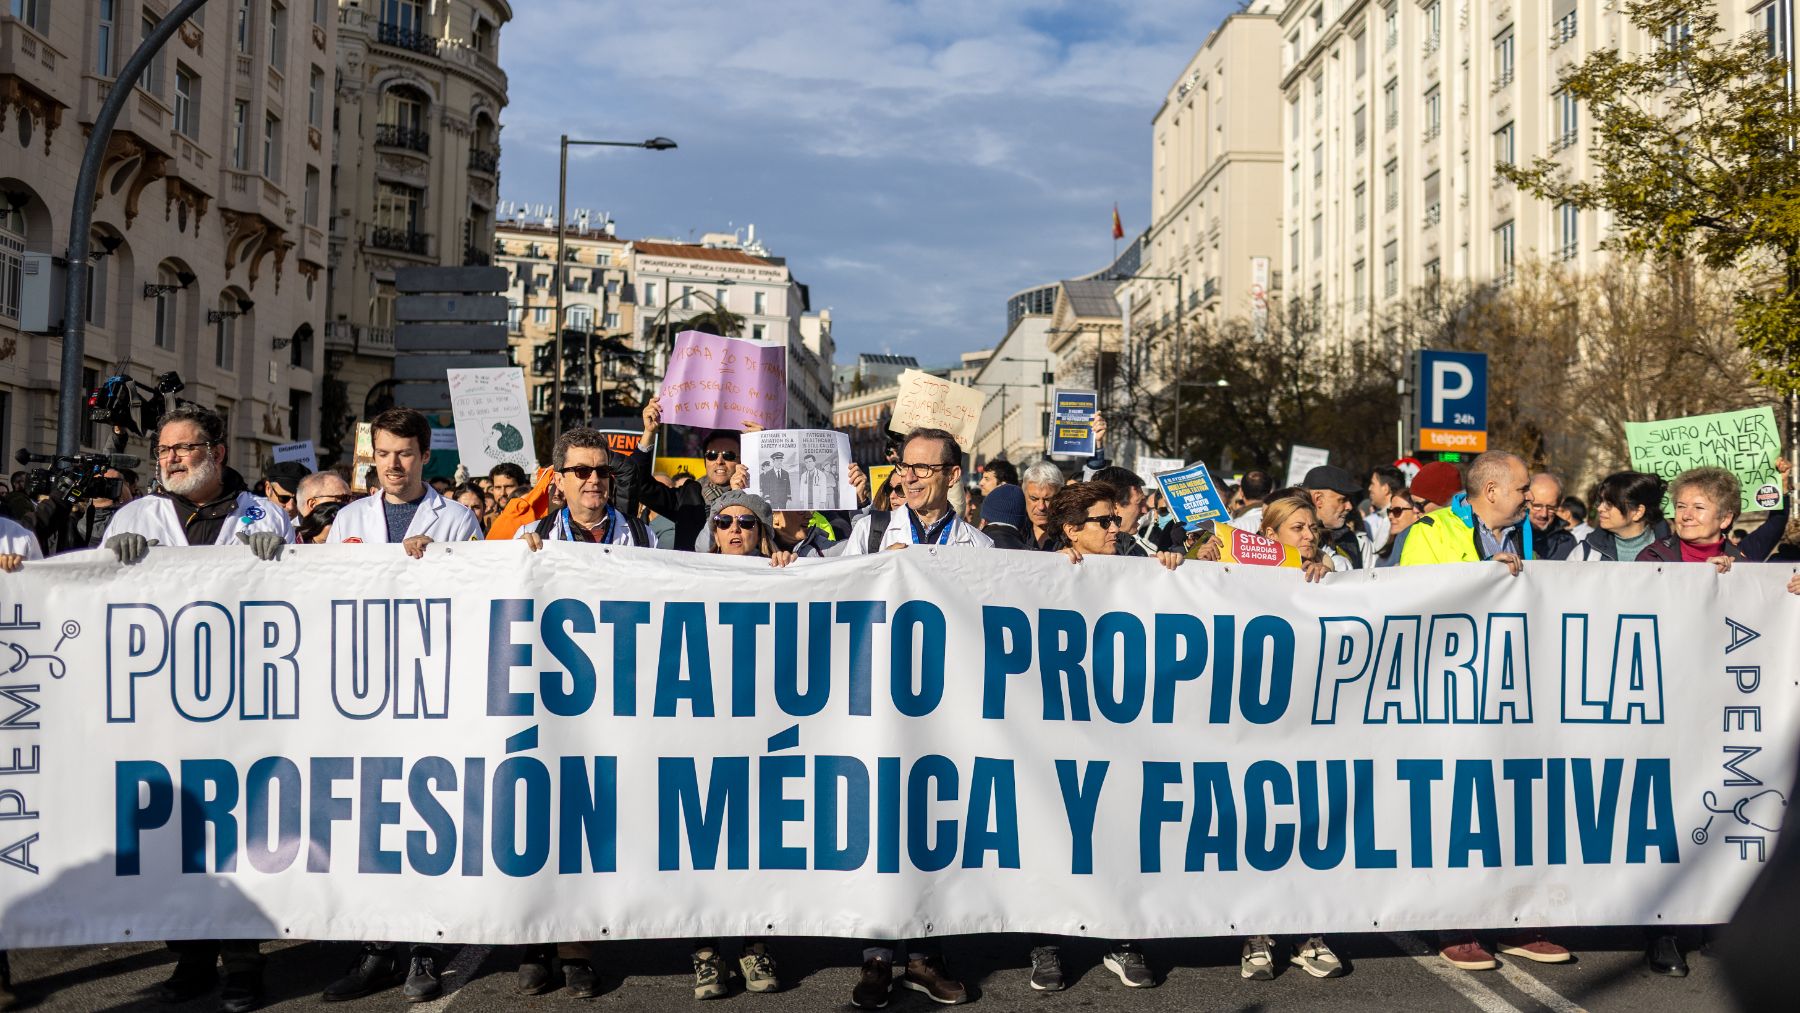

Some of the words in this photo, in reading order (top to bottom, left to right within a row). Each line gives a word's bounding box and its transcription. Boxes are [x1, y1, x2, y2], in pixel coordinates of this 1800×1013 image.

[676, 346, 713, 361] HORA
[699, 380, 741, 394] SEGURO
[909, 377, 950, 399] STOP
[1432, 360, 1473, 424] P
[675, 402, 690, 414] ME
[694, 402, 710, 411] VOY
[1454, 413, 1475, 425] 24h
[1646, 425, 1699, 444] SUFRO
[1705, 421, 1729, 438] AL
[1733, 414, 1768, 433] VER
[1431, 432, 1478, 447] telpark
[1634, 446, 1656, 460] DE
[1699, 432, 1777, 455] MANERA
[1716, 451, 1772, 471] NIETA
[1183, 494, 1195, 503] POR
[1194, 492, 1203, 500] UN
[1183, 498, 1209, 510] ESTATUTO
[1240, 533, 1275, 546] STOP
[1240, 544, 1277, 554] GUARDIAS
[1251, 553, 1277, 561] HORAS
[106, 600, 301, 724] POR
[330, 597, 452, 721] UN
[485, 597, 947, 718] ESTATUTO
[981, 603, 1296, 725] PROPIO
[1311, 612, 1535, 726] PARA
[1560, 612, 1665, 725] LA
[114, 724, 618, 878] PROFESIÓN
[657, 723, 1021, 874] MÉDICA
[1053, 759, 1111, 875] Y
[1139, 757, 1681, 873] FACULTATIVA
